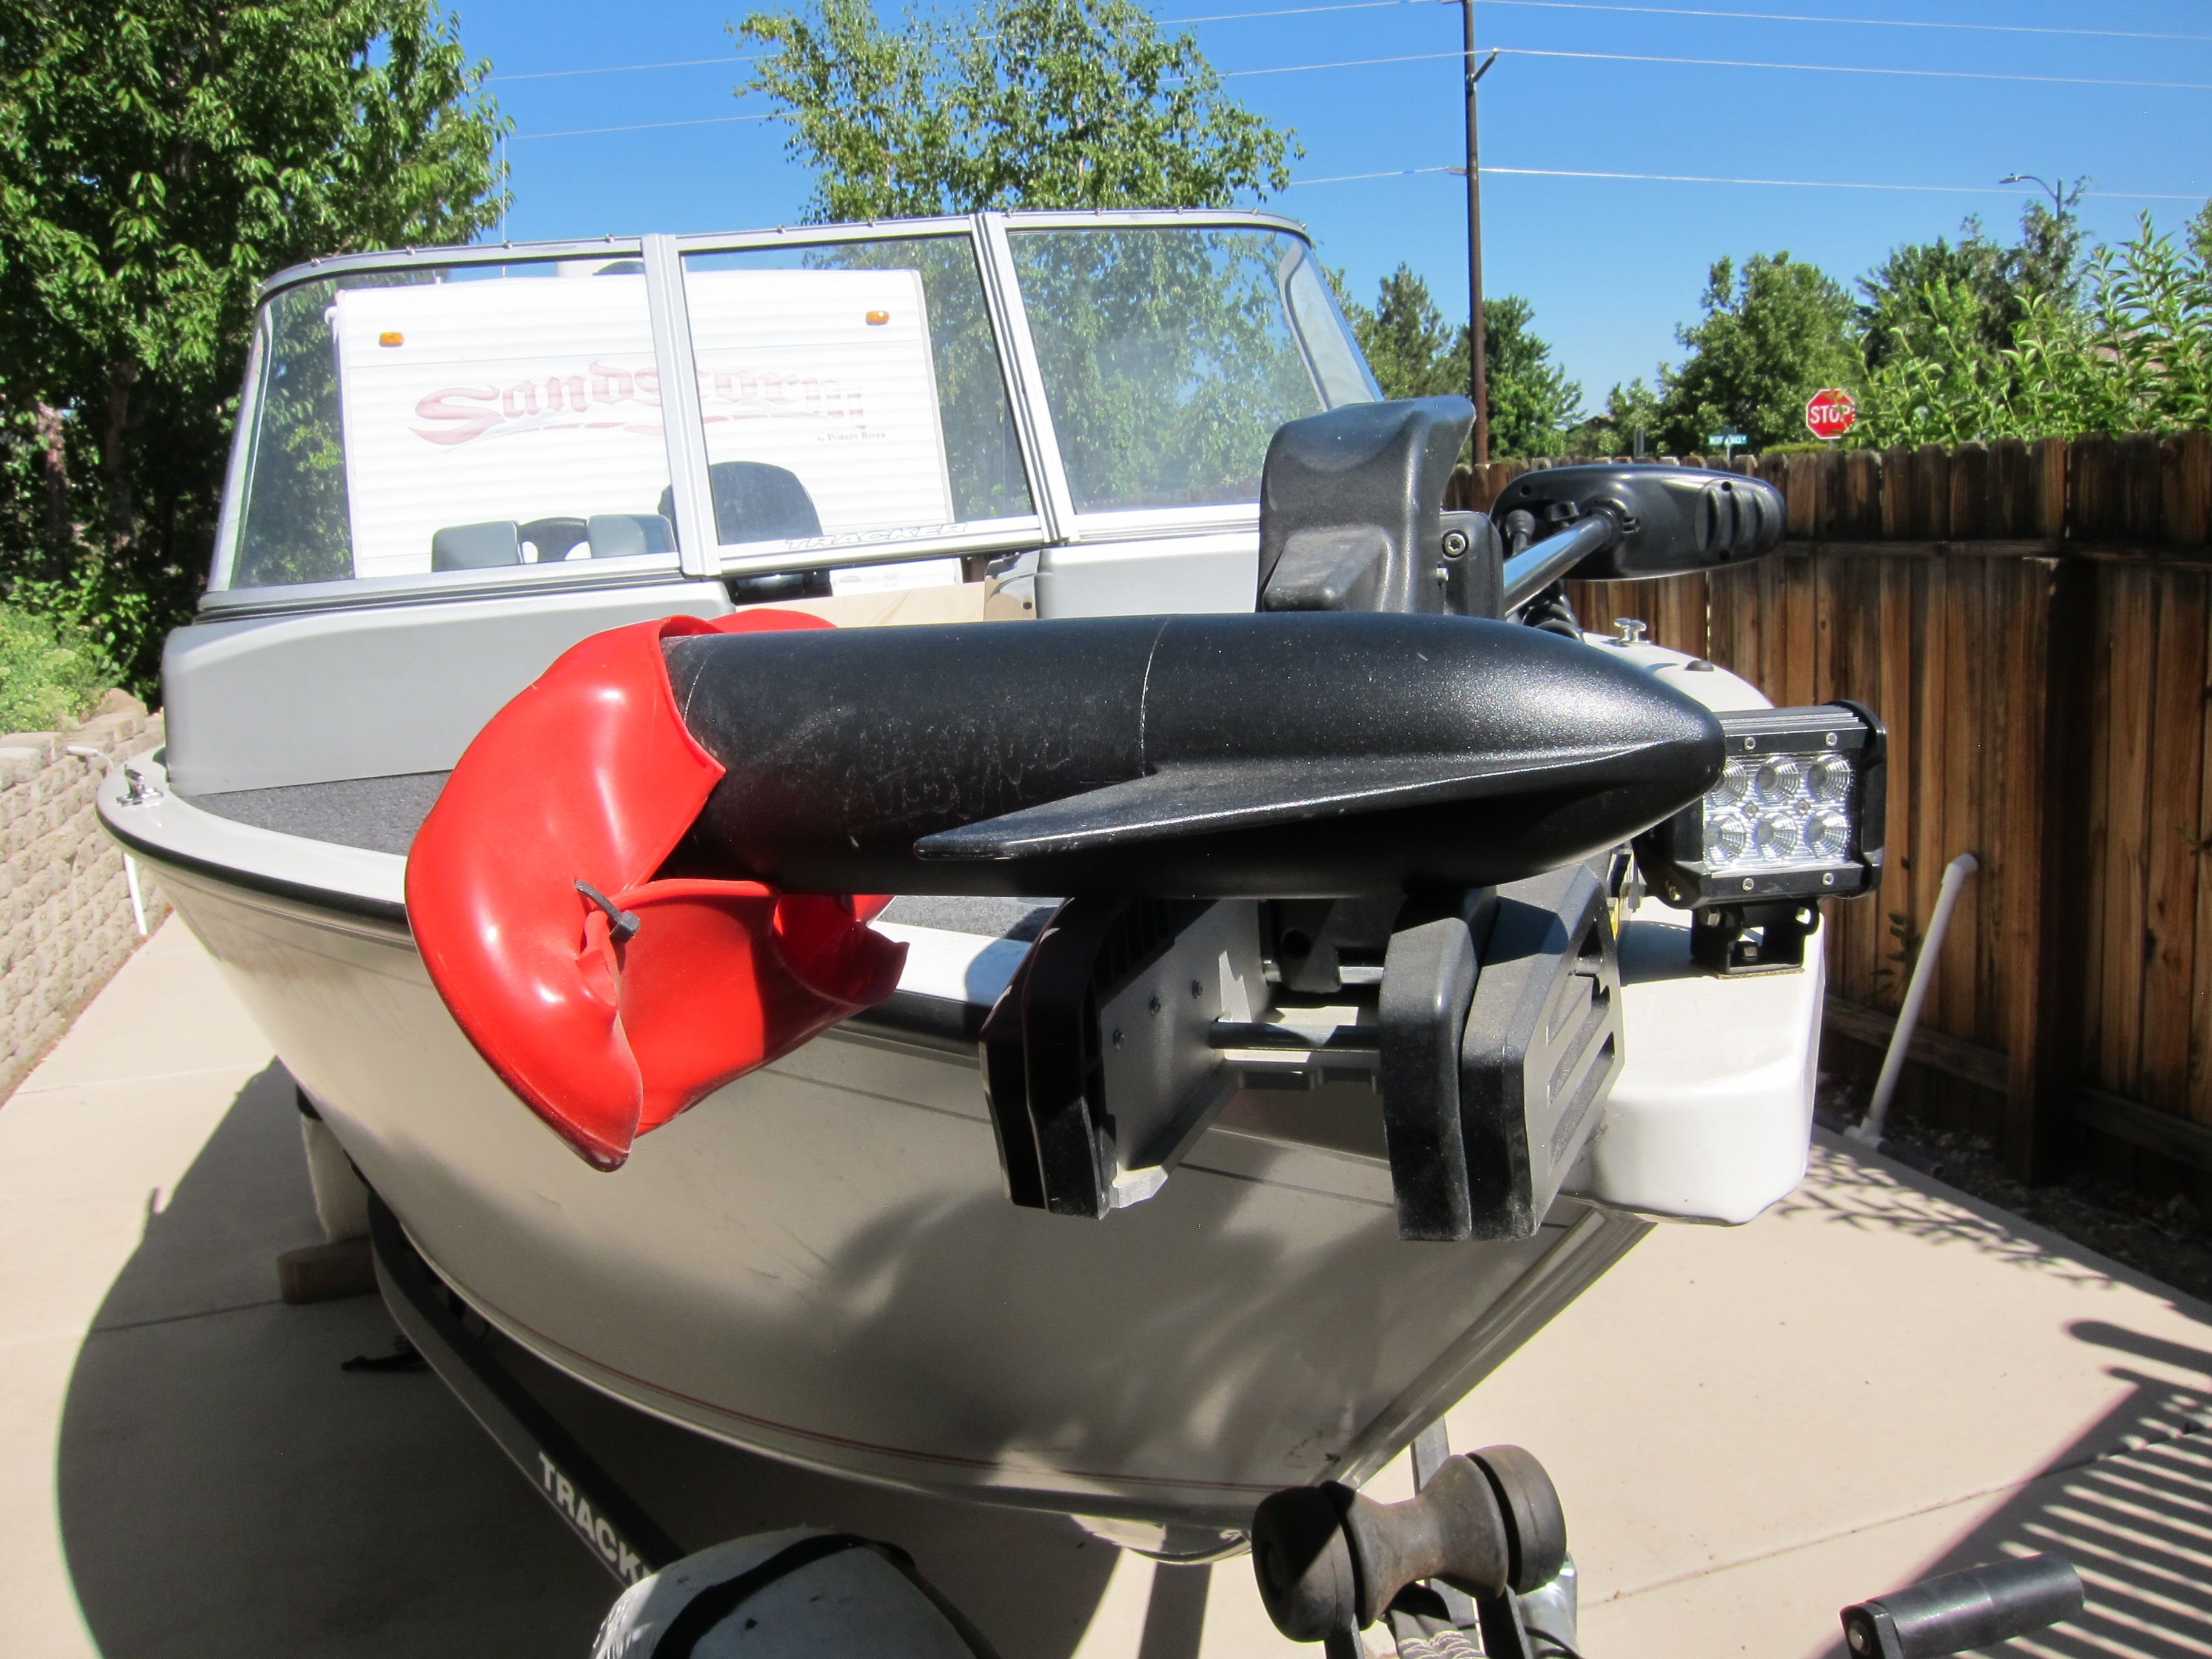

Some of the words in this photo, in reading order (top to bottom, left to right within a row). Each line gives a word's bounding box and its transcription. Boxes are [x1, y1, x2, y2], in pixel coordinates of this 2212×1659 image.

[407, 360, 867, 444] Sandsorm
[1809, 404, 1851, 424] STOP
[785, 522, 968, 550] TRACKER
